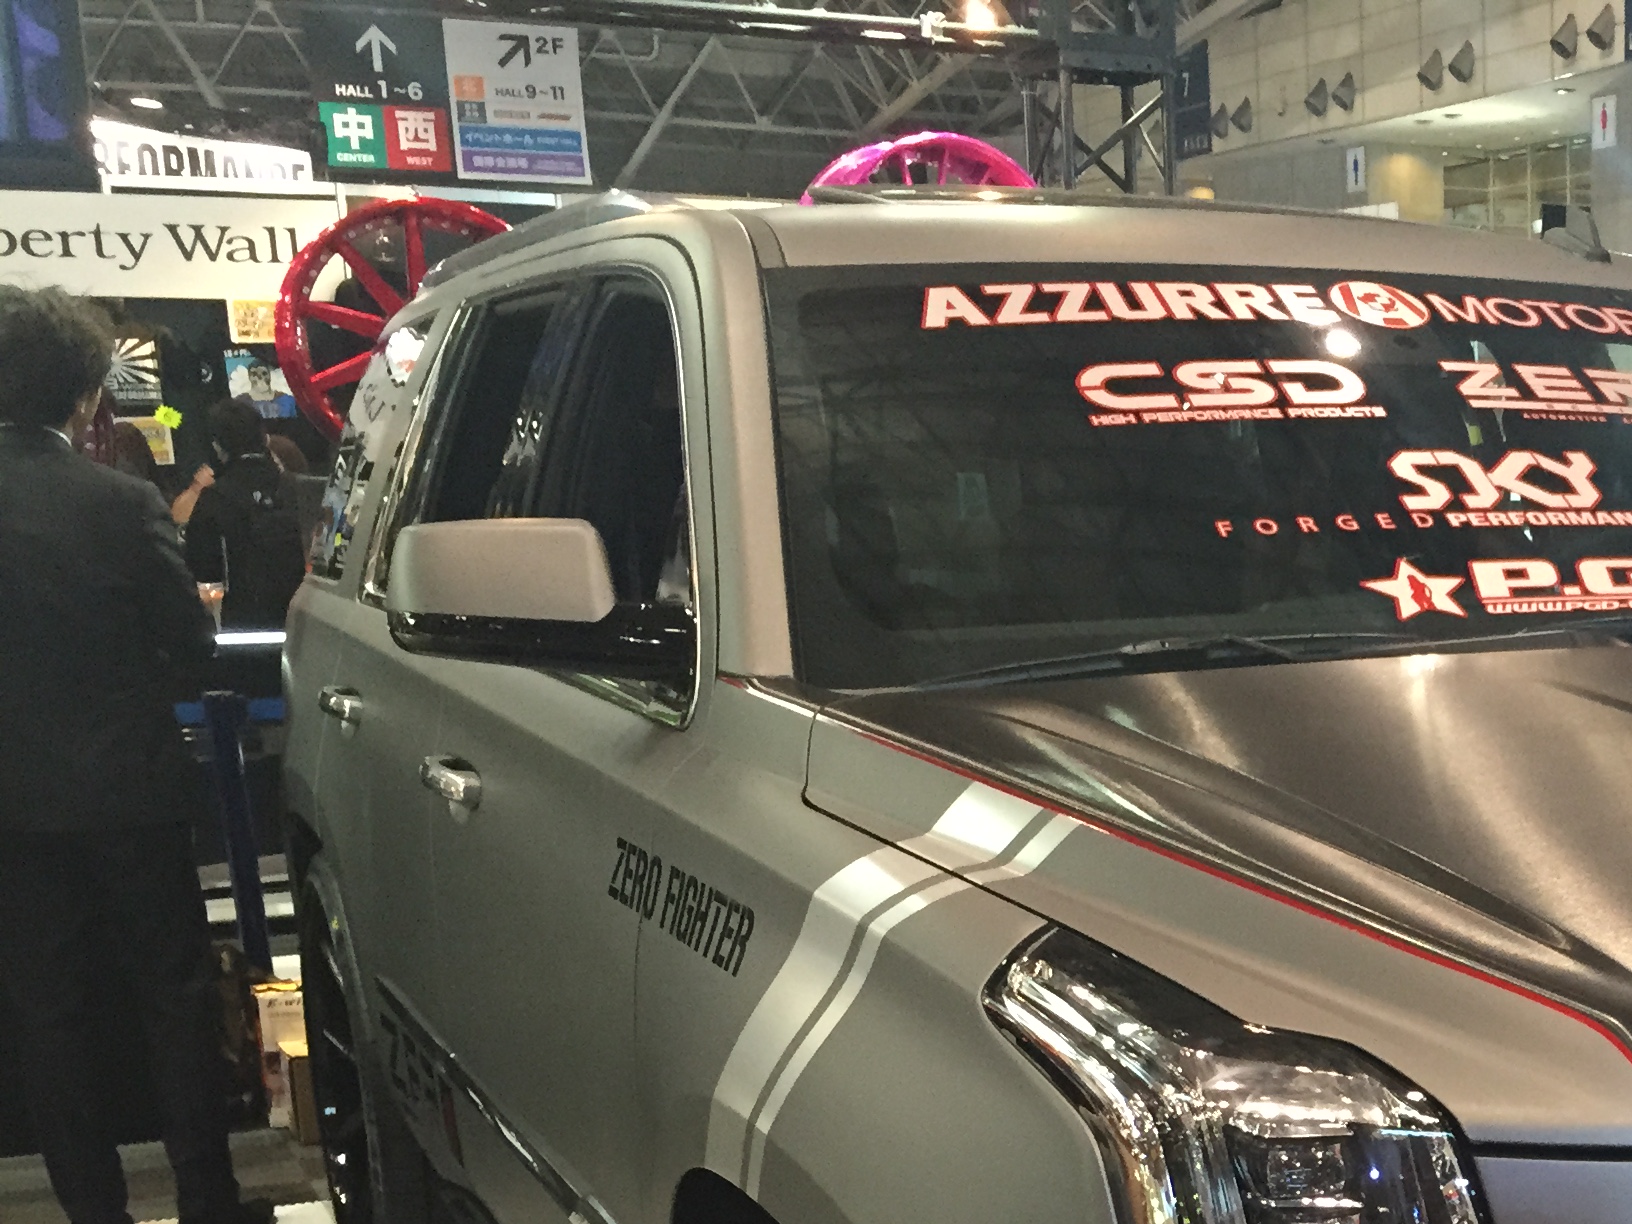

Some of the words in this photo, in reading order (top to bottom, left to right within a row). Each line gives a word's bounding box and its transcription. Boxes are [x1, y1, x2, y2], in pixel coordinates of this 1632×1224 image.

[534, 36, 564, 55] 2F
[334, 83, 373, 99] HALL
[494, 87, 524, 99] HALL
[332, 107, 374, 150] 中
[394, 109, 437, 152] 西
[336, 153, 375, 163] CENTER
[406, 156, 433, 167] WEST
[921, 281, 1342, 329] AZZURRE
[1075, 359, 1367, 410] CSD
[1089, 413, 1138, 426] HIGH
[1140, 408, 1284, 425] PERFORMANCE
[1286, 405, 1388, 420] PRODUCTS
[1386, 448, 1602, 511] SKY
[1214, 511, 1434, 538] FORGED
[607, 836, 662, 920] ZERO
[659, 865, 755, 977] FIGHTER
